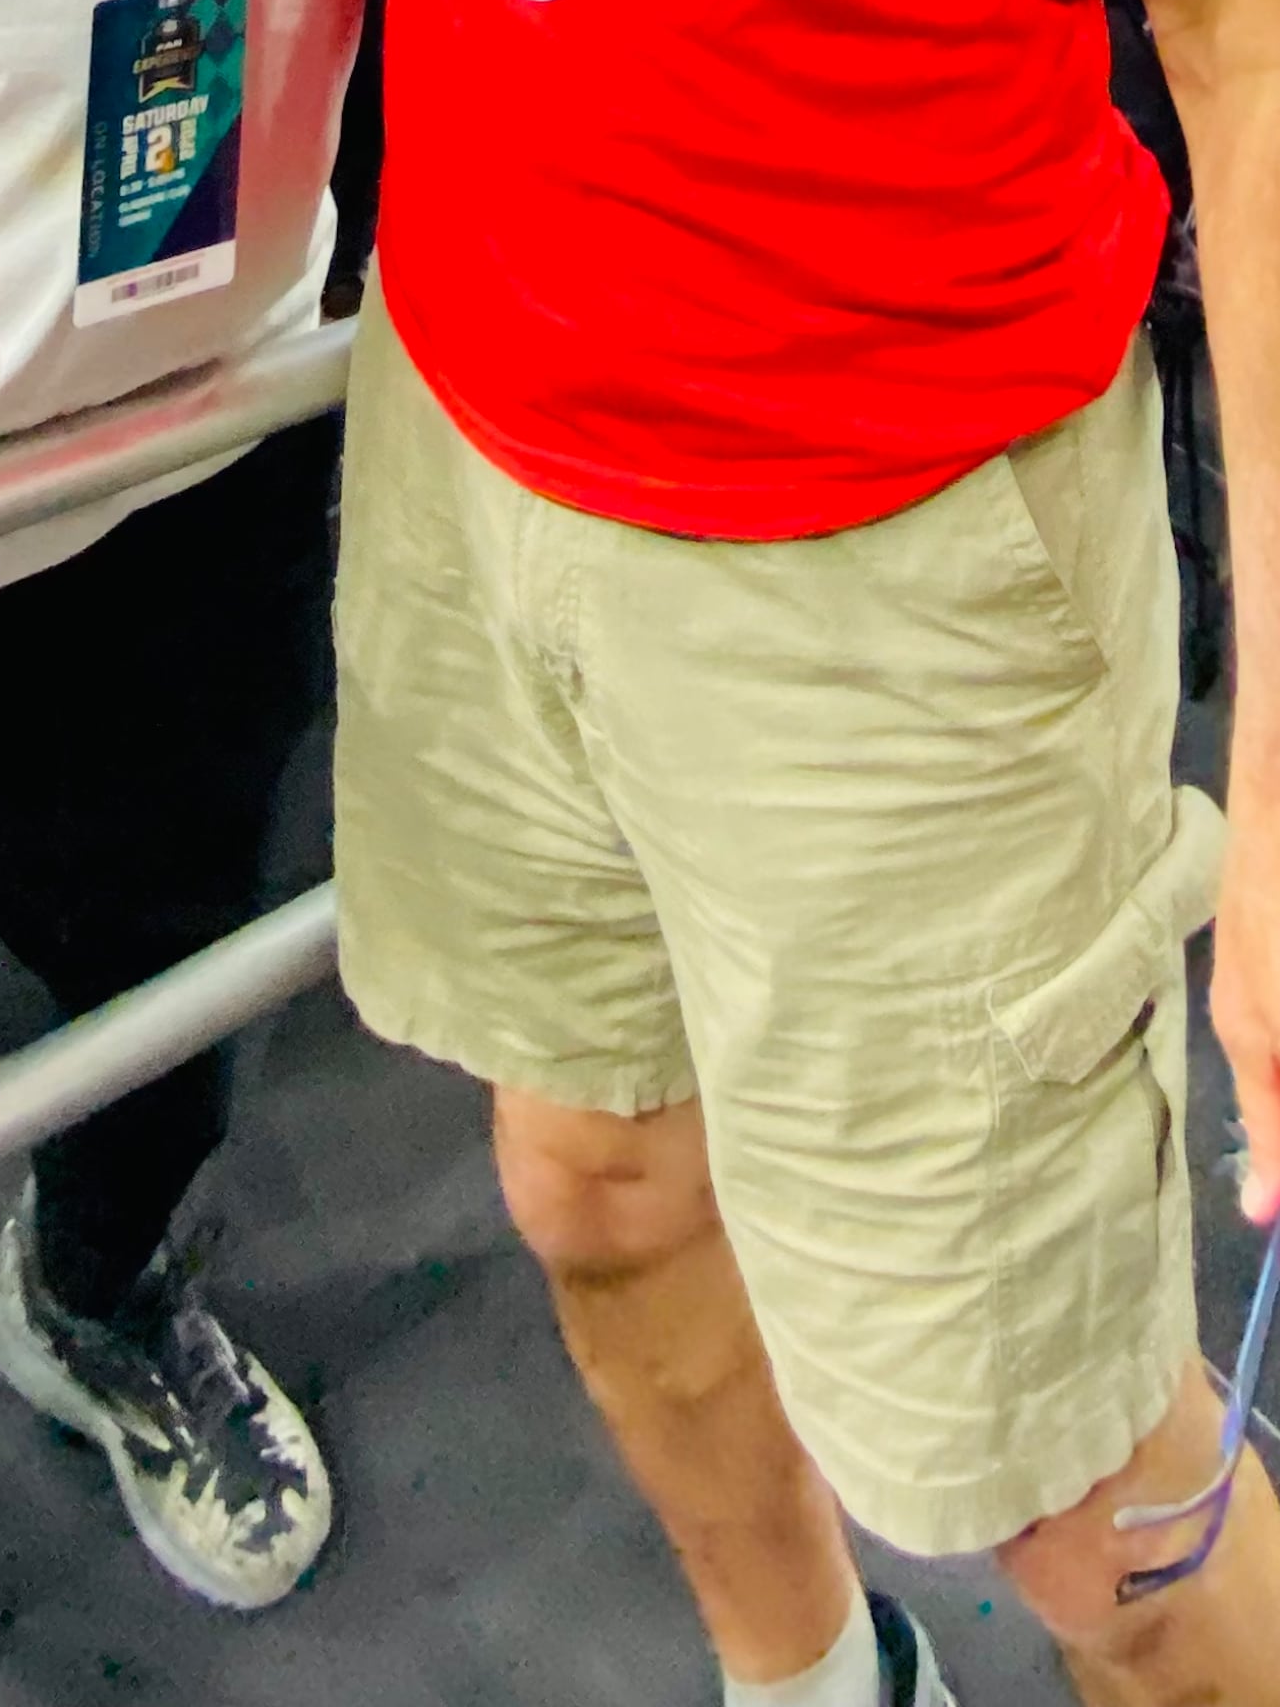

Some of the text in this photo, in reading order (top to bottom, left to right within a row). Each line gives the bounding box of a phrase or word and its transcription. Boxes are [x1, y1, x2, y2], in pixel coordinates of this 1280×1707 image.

[123, 93, 210, 136] SATURDAY
[144, 127, 175, 174] 2
[87, 157, 108, 258] LOCATION
